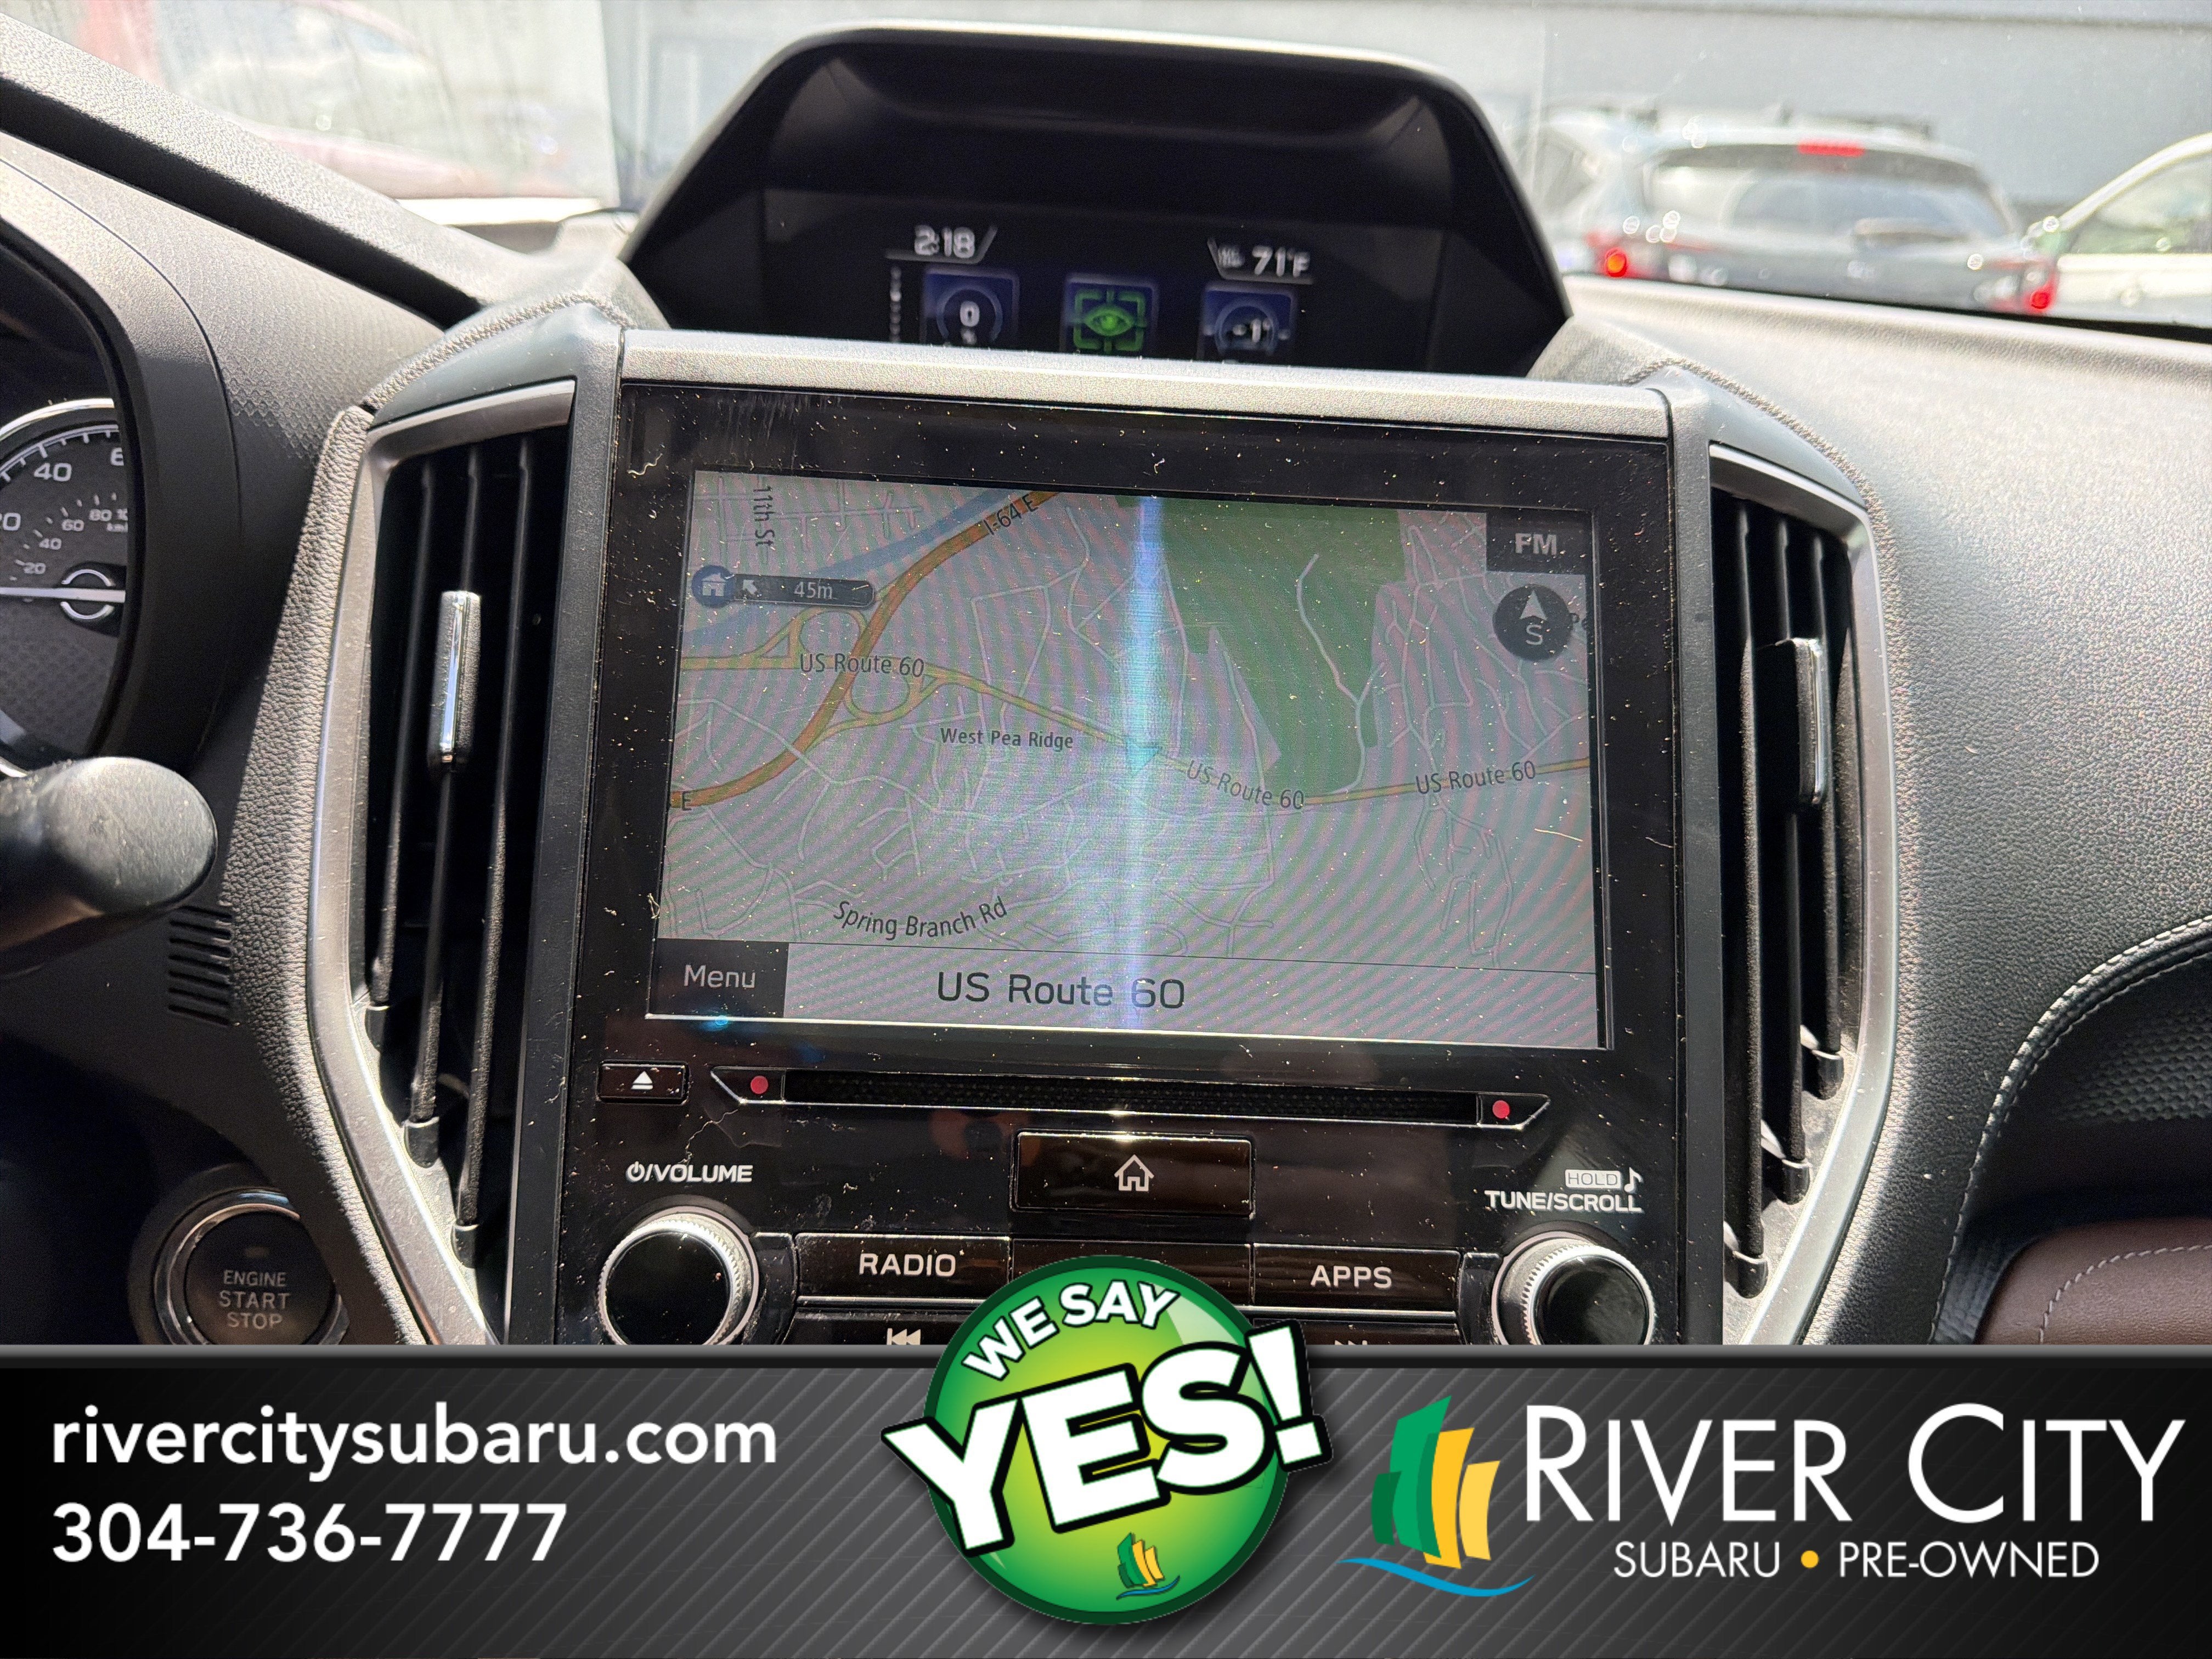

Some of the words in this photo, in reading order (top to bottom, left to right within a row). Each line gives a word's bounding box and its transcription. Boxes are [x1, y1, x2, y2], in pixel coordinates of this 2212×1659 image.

[914, 225, 975, 258] 2:18
[33, 463, 72, 482] 40
[753, 486, 776, 521] 11th
[0, 512, 21, 531] 0
[61, 519, 84, 532] 60
[89, 509, 112, 521] 80
[39, 537, 61, 550] 40
[755, 529, 775, 546] St
[1515, 533, 1557, 555] FM
[23, 562, 46, 574] 20
[794, 582, 833, 600] 45m
[1525, 624, 1543, 645] S
[800, 652, 826, 673] US
[834, 653, 892, 674] Route
[899, 656, 924, 678] 60
[940, 727, 984, 744] West
[991, 730, 1022, 747] Pea
[1029, 731, 1074, 752] Ridge
[1187, 760, 1211, 786] US
[1217, 772, 1273, 806] Route
[1279, 788, 1305, 810] 60
[1415, 774, 1442, 795] US
[1449, 766, 1506, 790] Route
[1511, 759, 1537, 782] 60
[833, 900, 898, 941] Spring
[905, 911, 977, 938] Branch
[979, 895, 1008, 924] Rd
[684, 964, 757, 989] Menu
[936, 971, 990, 1003] US
[1008, 973, 1113, 1007] Route
[1131, 977, 1185, 1009] 60
[1567, 1172, 1619, 1186] HOLD
[1483, 1190, 1644, 1214] TUNE/SCROLL
[858, 1253, 957, 1278] RADIO
[223, 1269, 287, 1287] ENGINE
[1310, 1264, 1393, 1289] APPS
[219, 1289, 290, 1310] START
[226, 1312, 283, 1330] STOP
